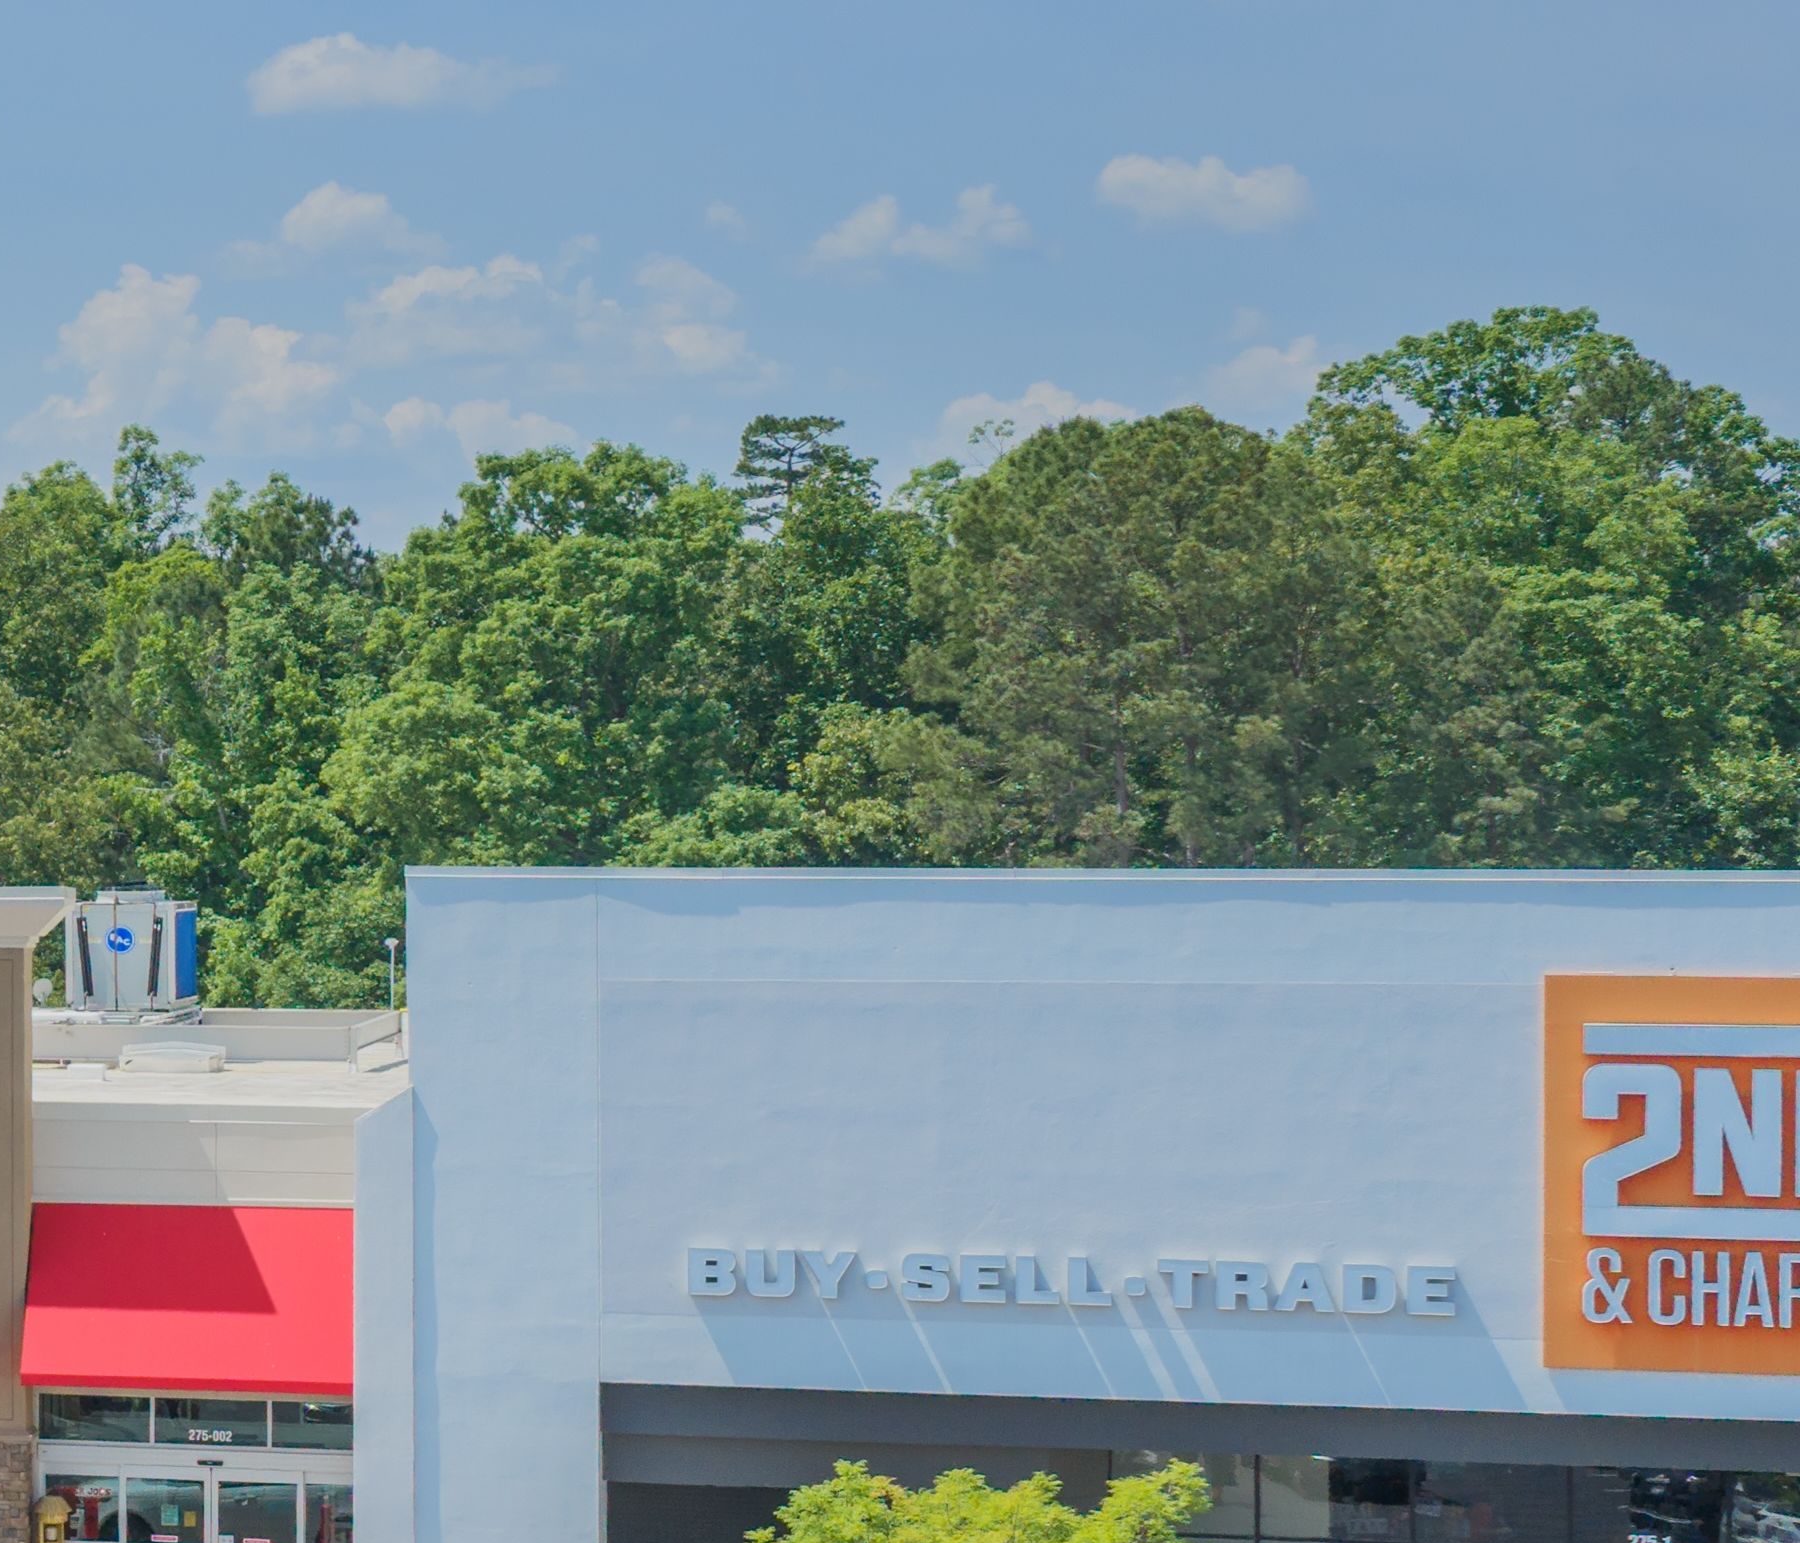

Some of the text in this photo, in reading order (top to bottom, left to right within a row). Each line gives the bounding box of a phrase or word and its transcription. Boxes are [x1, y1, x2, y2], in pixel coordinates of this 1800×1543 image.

[1581, 1062, 1800, 1239] 2N
[687, 1247, 1457, 1317] BUY SELL TRADE
[1581, 1247, 1633, 1328] &
[188, 1429, 232, 1442] 275-002
